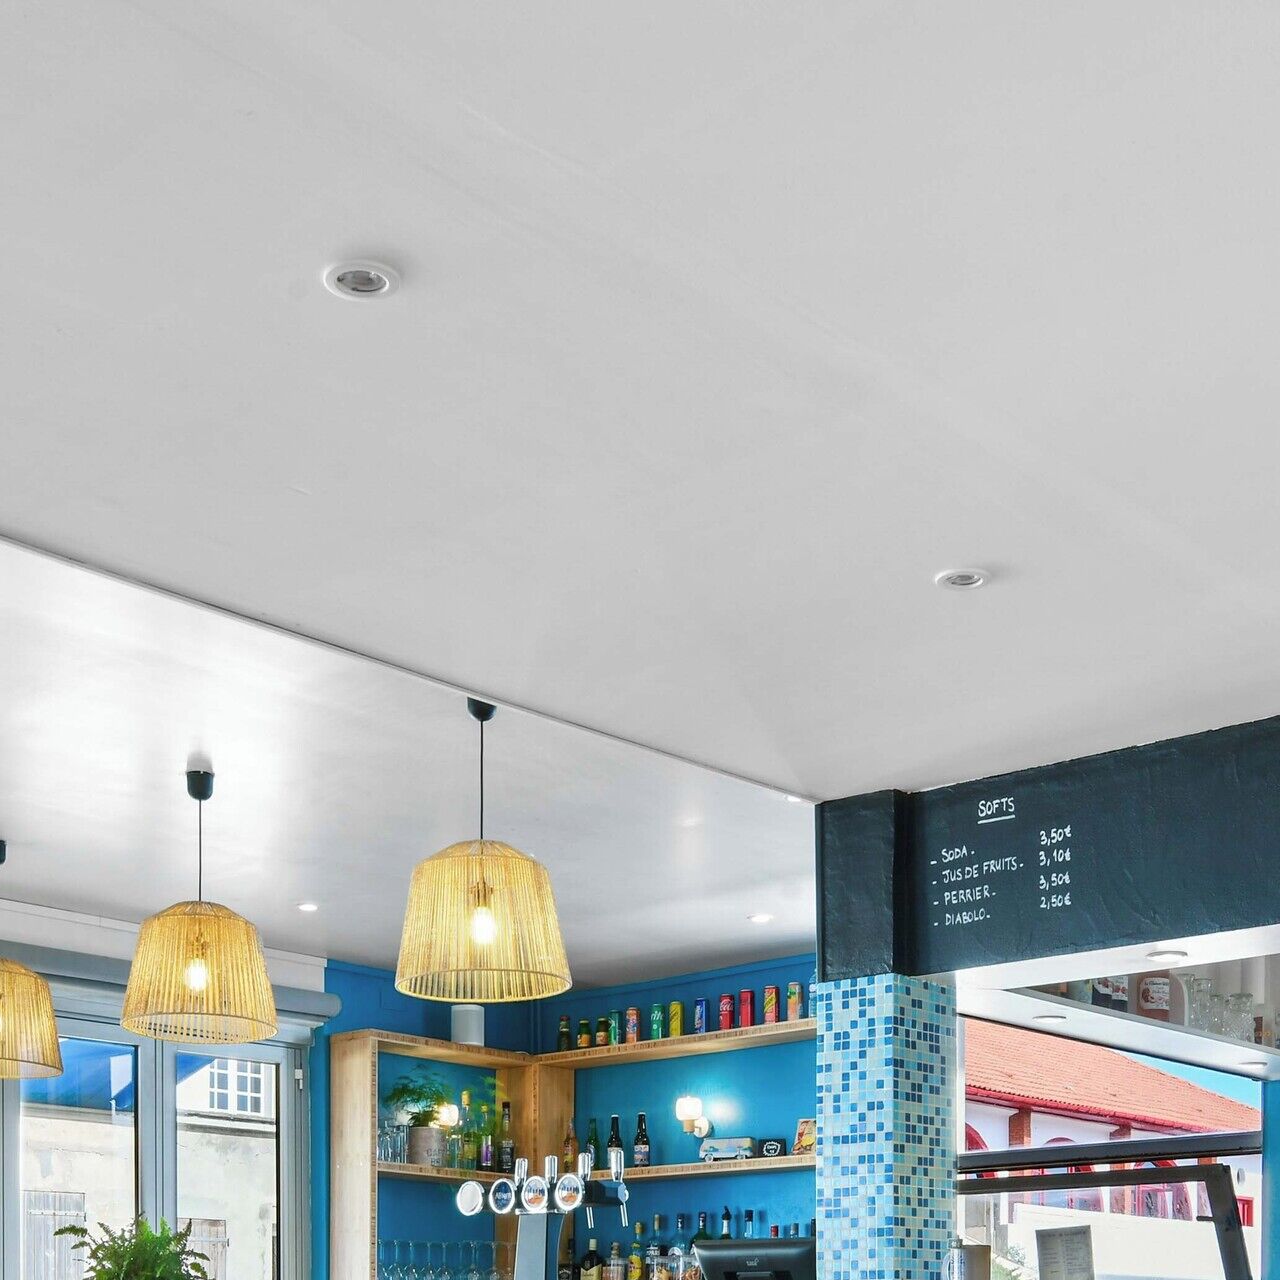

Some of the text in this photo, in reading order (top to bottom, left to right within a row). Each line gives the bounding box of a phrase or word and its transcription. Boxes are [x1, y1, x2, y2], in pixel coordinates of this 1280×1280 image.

[977, 796, 1015, 818] SOFTS
[941, 868, 963, 884] JUS
[964, 863, 979, 879] DE
